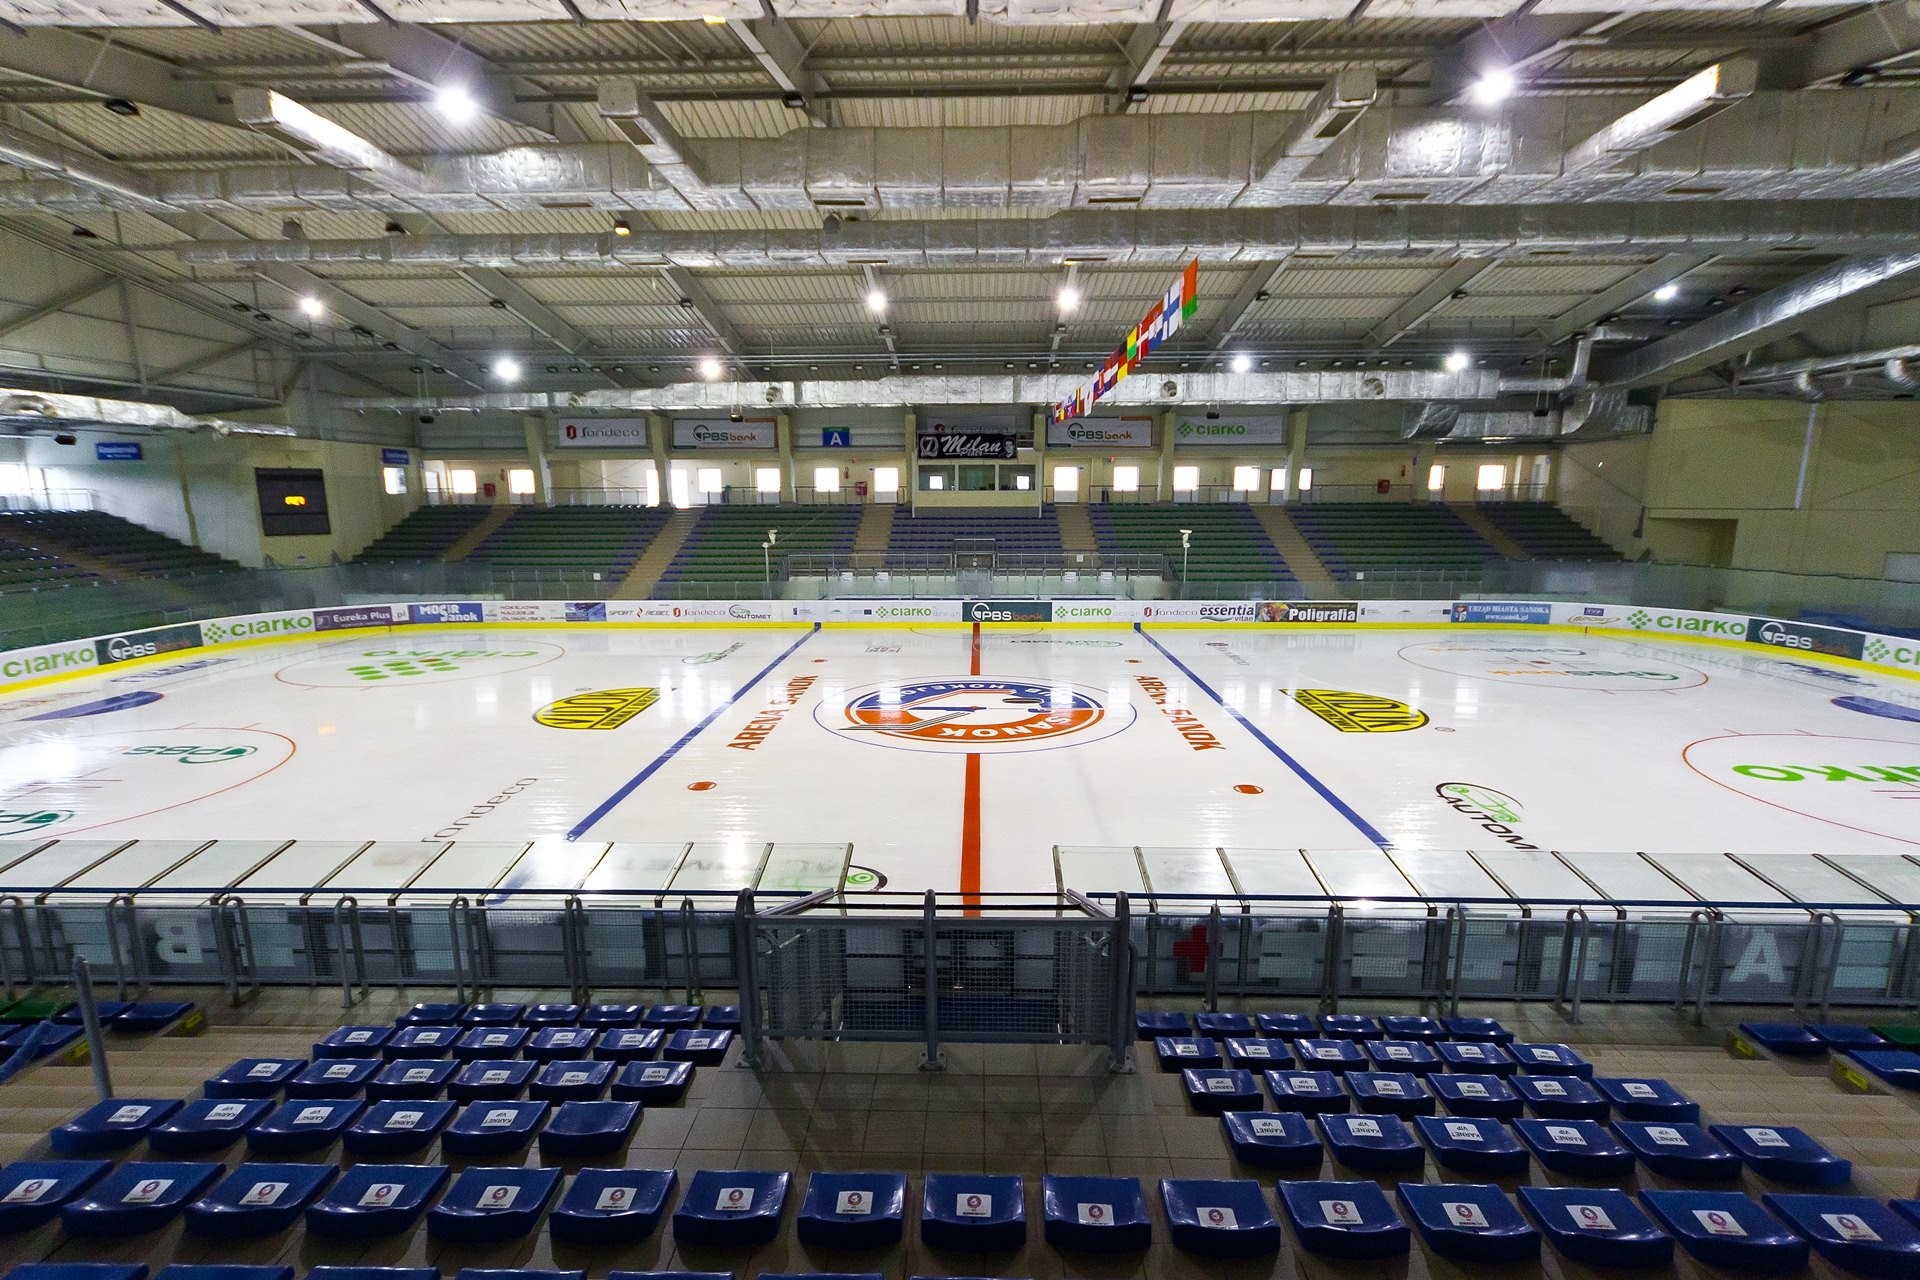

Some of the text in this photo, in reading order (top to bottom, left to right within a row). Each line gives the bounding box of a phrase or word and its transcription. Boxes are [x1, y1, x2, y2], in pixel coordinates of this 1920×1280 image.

[830, 432, 842, 446] A
[940, 434, 1002, 452] Milan
[332, 611, 390, 623] Eureka Plus
[1200, 604, 1254, 616] essentia
[1288, 608, 1356, 622] Poligrafia
[726, 708, 790, 751] ARENA
[936, 716, 1071, 738] SANOK
[1161, 708, 1226, 752] SANOK
[1729, 928, 1786, 983] A
